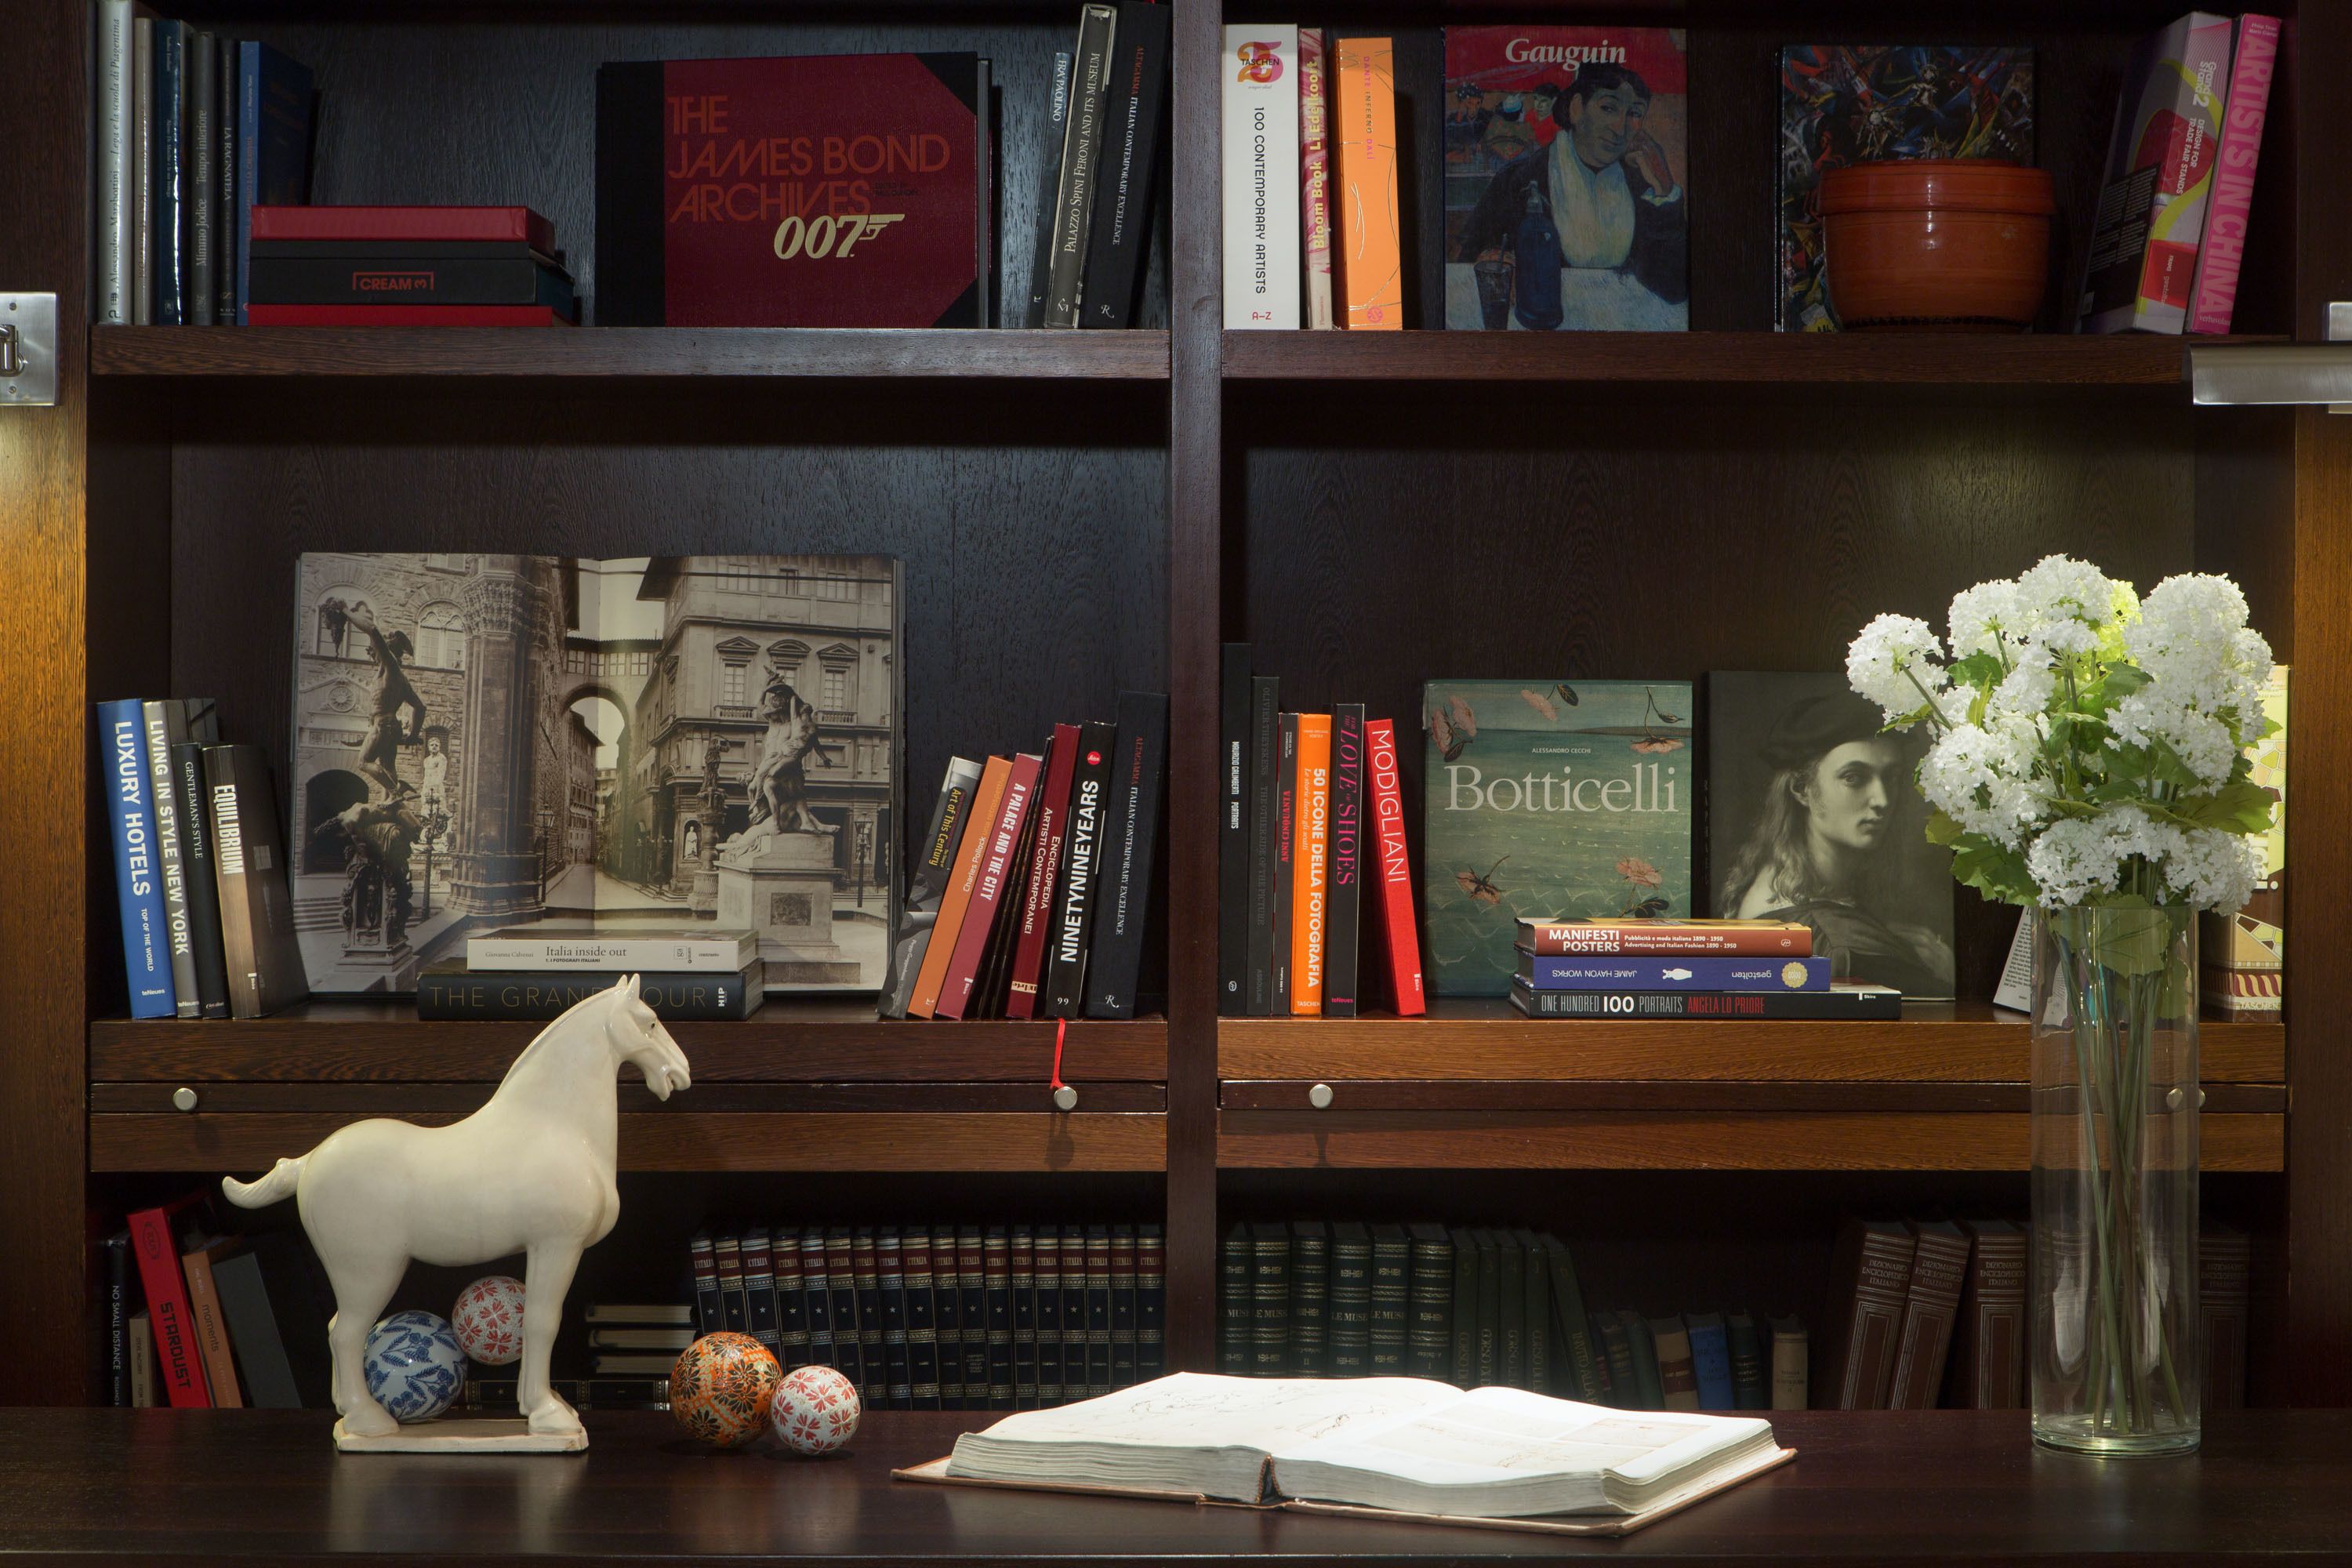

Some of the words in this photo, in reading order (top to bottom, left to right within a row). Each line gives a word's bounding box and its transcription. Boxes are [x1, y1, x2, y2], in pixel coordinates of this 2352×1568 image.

[1504, 38, 1627, 71] Gauguin
[1087, 53, 1101, 96] MUSEUM
[1053, 79, 1065, 122] PAOLINO
[1084, 97, 1095, 113] ITS
[1127, 96, 1138, 129] ITALIAN
[1308, 60, 1321, 132] Edelkoort
[2224, 33, 2278, 170] ARTISTS
[196, 109, 207, 150] interiore
[668, 95, 728, 134] THE
[1081, 114, 1093, 137] AND
[1254, 107, 1265, 131] 100
[2186, 118, 2196, 143] TRADE
[224, 127, 232, 140] LA
[1309, 137, 1321, 151] Li
[2194, 118, 2205, 149] DESIGN
[196, 152, 209, 185] Tempo
[224, 141, 233, 201] RAGNATELA
[668, 136, 812, 179] JAMES
[823, 133, 951, 176] BOND
[1074, 139, 1090, 177] FERONI
[1119, 129, 1134, 194] CONTEMPORARY
[2182, 143, 2192, 163] FAIR
[2190, 149, 2200, 168] FOR
[1069, 180, 1085, 206] SPINI
[1254, 135, 1265, 240] CONTEMPORARY
[1310, 162, 1323, 198] Book
[2176, 163, 2188, 194] STANDS
[2217, 173, 2255, 209] IN
[196, 198, 209, 229] Jodice
[670, 180, 871, 223] ARCHIVES
[774, 213, 906, 260] 007
[1064, 209, 1080, 253] PALAZZO
[1112, 195, 1126, 245] EXCELLENCE
[1312, 202, 1325, 249] Bloom
[196, 230, 207, 267] Mimmo
[2199, 213, 2248, 314] CHINA
[360, 278, 412, 290] CREAM
[1255, 244, 1266, 294] ARTISTS
[115, 720, 141, 805] LUXURY
[149, 720, 169, 776] LIVING
[1232, 741, 1240, 765] MAURIZIO
[1339, 728, 1359, 794] LOVE
[157, 782, 171, 800] IN
[1014, 782, 1026, 792] A
[1231, 766, 1240, 795] GALIMBERTI
[1313, 768, 1326, 786] 50
[1443, 762, 1679, 812] Botticelli
[185, 761, 200, 829] GENTLEMAN'S
[193, 829, 203, 859] STYLE
[946, 804, 956, 815] of
[949, 788, 962, 804] Art
[1002, 793, 1024, 831] PALACE
[1127, 786, 1138, 818] ITALIAN
[1371, 729, 1406, 883] MODIGLIANI
[160, 805, 178, 858] STYLE
[213, 784, 245, 875] EQUILIBRIUM
[941, 814, 955, 833] This
[1039, 807, 1054, 846] ARTISTI
[1231, 801, 1240, 829] PORTRAITS
[1282, 790, 1291, 840] CINQUANTA
[1311, 790, 1326, 840] ICONE
[125, 813, 151, 896] HOTELS
[928, 833, 949, 866] Century
[995, 831, 1011, 855] AND
[1121, 819, 1135, 884] CONTEMPORARY
[1281, 841, 1290, 862] ANNI
[1336, 803, 1356, 885] SHOES
[964, 863, 978, 892] Charles
[972, 836, 986, 863] Pollock
[987, 855, 1005, 876] THE
[1040, 836, 1061, 910] ENCICLOPEDIA
[1060, 780, 1099, 963] NINETYNINEYEARS
[1310, 844, 1323, 887] DELLA
[166, 863, 183, 902] NEW
[980, 876, 998, 901] CITY
[1024, 848, 1047, 935] CONTEMPORANEI
[143, 921, 150, 932] OF
[1116, 885, 1128, 935] EXCELLENCE
[143, 932, 152, 946] THE
[171, 909, 189, 956] YORK
[1308, 891, 1323, 988] FOTOGRAFIA
[1548, 929, 1620, 941] MANIFESTI
[1563, 941, 1620, 953] POSTERS
[145, 946, 154, 972] WORLD
[546, 946, 572, 956] Italia
[575, 946, 607, 956] inside
[608, 948, 627, 956] out
[1552, 969, 1582, 978] WORKS
[1584, 969, 1613, 978] HAYON
[1613, 969, 1637, 978] JAIME
[1731, 969, 1772, 980] gestalten
[429, 986, 486, 1008] THE
[717, 986, 726, 1007] HIP
[1541, 995, 1557, 1012] ONE
[1561, 995, 1599, 1012] HUNDRED
[1603, 996, 1635, 1013] 100
[1639, 996, 1682, 1013] PORTRAITS
[1687, 996, 1719, 1014] ANGELA
[1721, 996, 1732, 1014] LO
[1734, 996, 1765, 1014] PRIORE
[1869, 1259, 1907, 1272] DIZIONARIO
[1869, 1278, 1900, 1288] ITALIANO
[112, 1285, 120, 1300] NO
[161, 1301, 191, 1388] STARDUST
[202, 1304, 220, 1353] moments
[112, 1330, 121, 1370] DISTANCE
